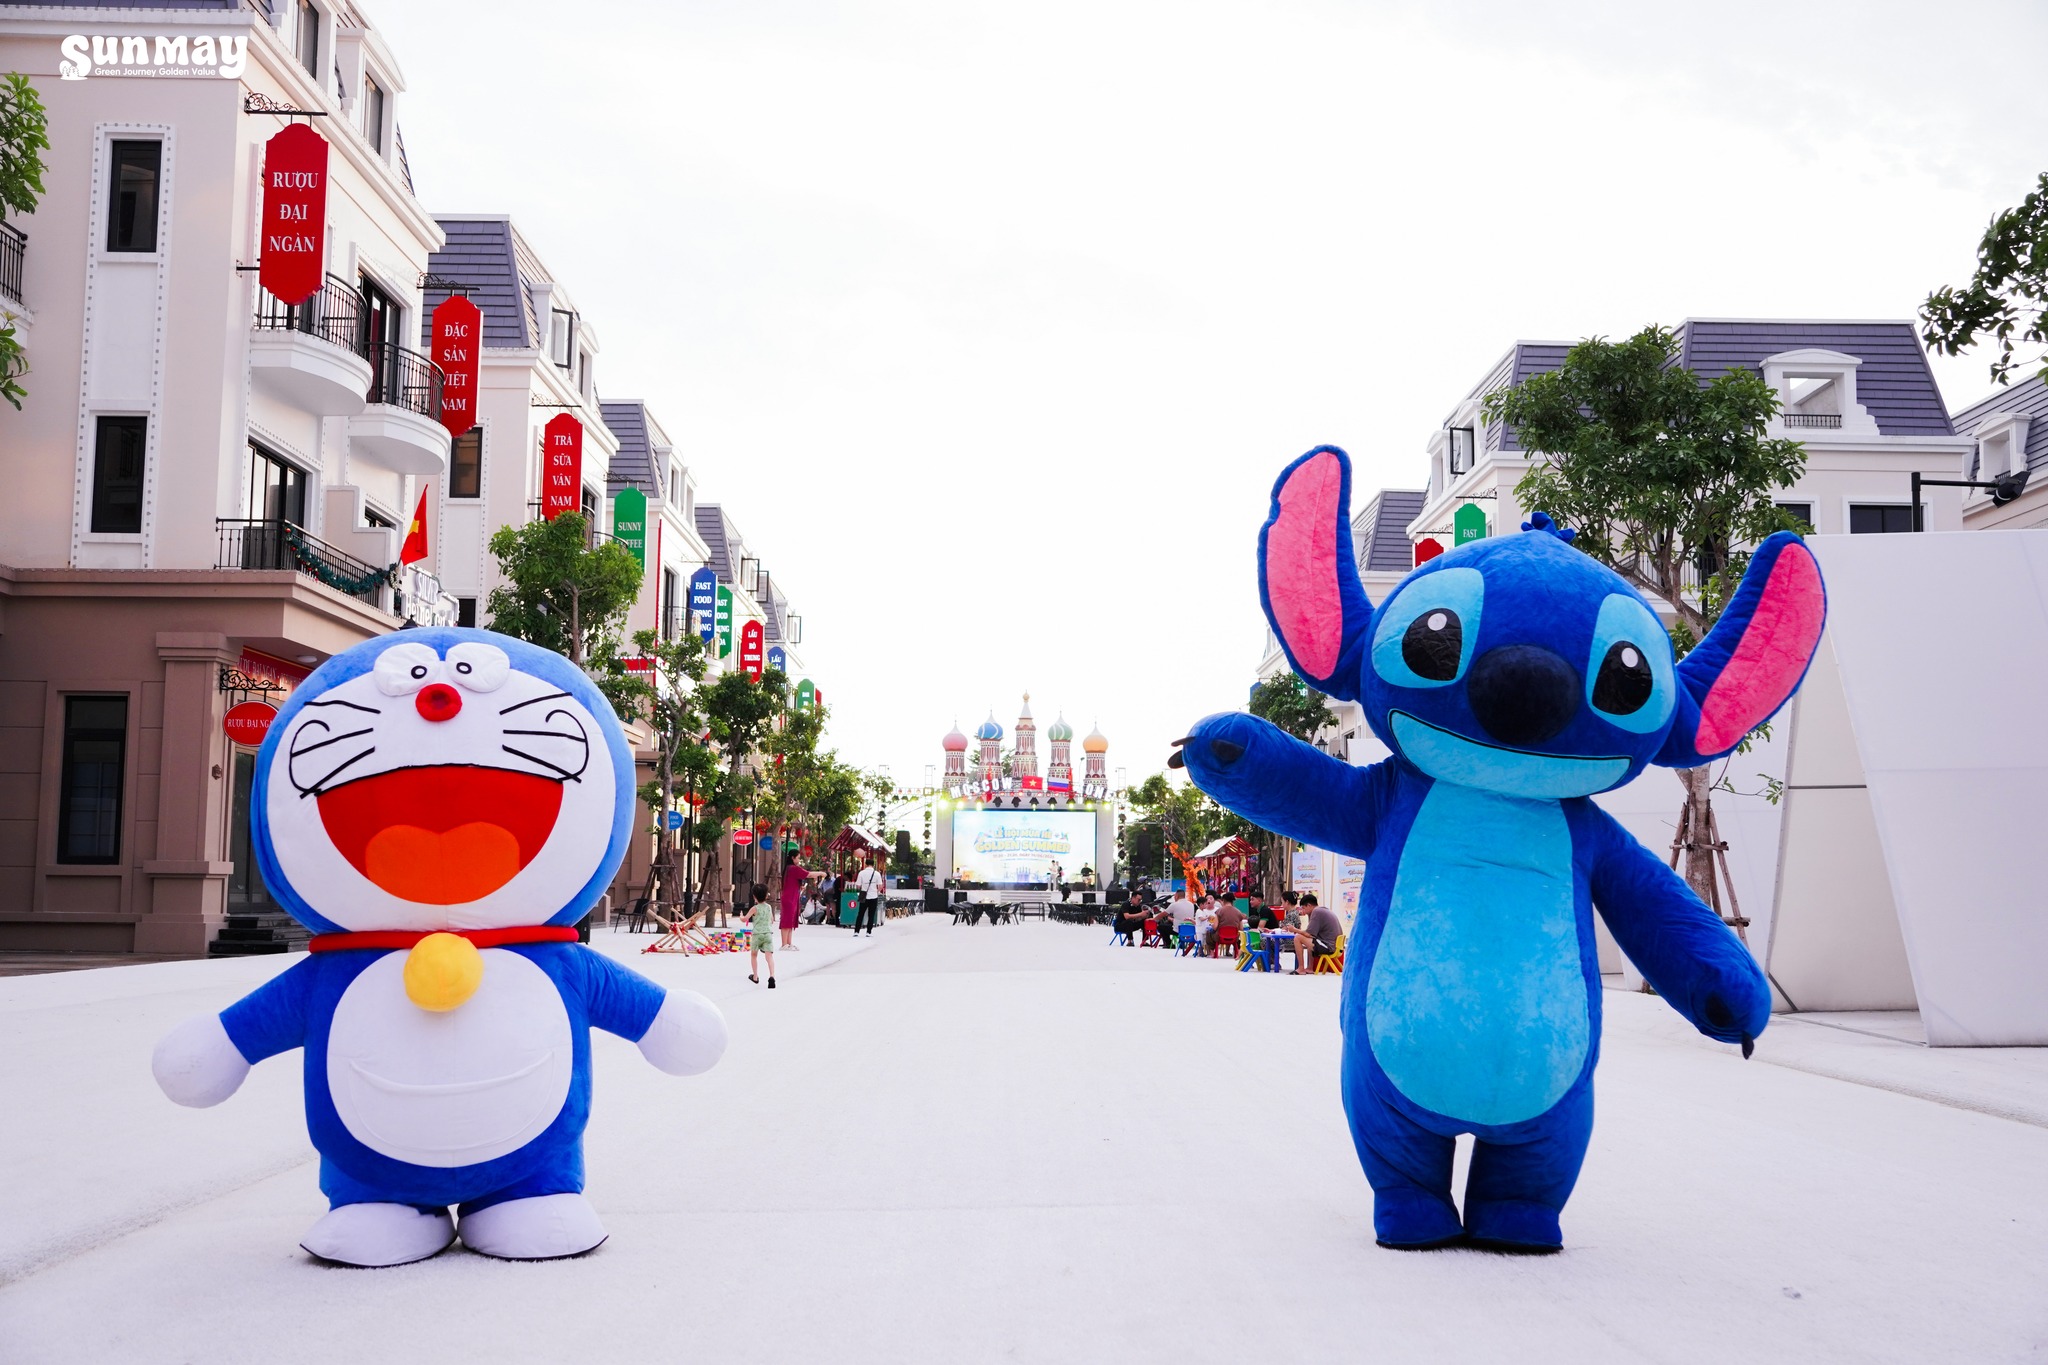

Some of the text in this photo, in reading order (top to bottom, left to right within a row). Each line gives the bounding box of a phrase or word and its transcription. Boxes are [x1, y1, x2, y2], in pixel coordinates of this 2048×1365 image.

[272, 171, 319, 192] RƯỢU
[279, 203, 308, 224] ĐẠI
[269, 232, 316, 252] NGÀN
[444, 322, 468, 340] ĐẶC
[443, 344, 467, 362] SẢN
[441, 398, 467, 411] NAM
[553, 432, 573, 446] TRÀ
[553, 452, 573, 466] SỮA
[550, 495, 572, 506] NAM
[617, 521, 642, 531] SUNNY
[1462, 528, 1478, 538] FAST
[695, 582, 711, 590] FAST
[693, 596, 712, 604] FOOD
[716, 612, 728, 620] OOD
[950, 776, 1013, 799] MOSCOW
[1021, 840, 1071, 854] SUMMER
